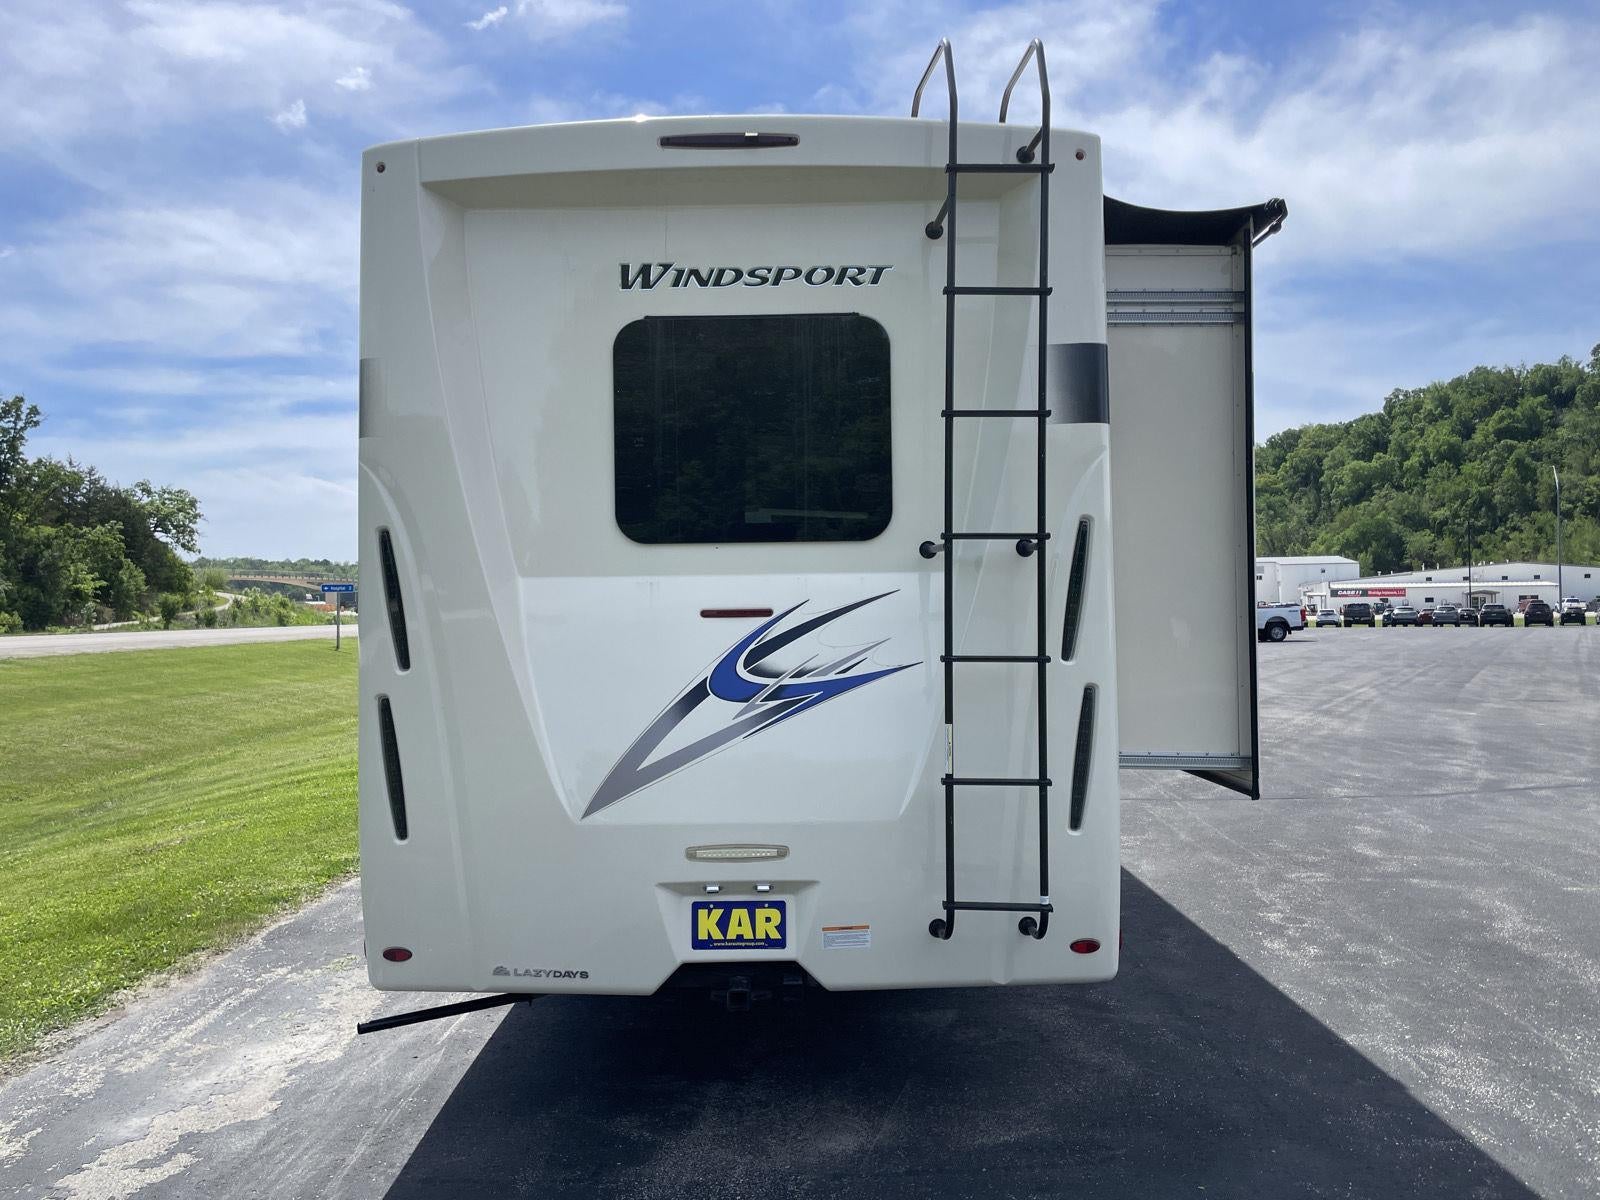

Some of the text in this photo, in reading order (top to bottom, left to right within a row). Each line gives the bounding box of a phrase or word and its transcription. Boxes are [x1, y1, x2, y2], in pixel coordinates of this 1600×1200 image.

[619, 262, 894, 291] WINDSPORT
[697, 908, 782, 940] KAR
[513, 968, 590, 979] LAZYDAYS
